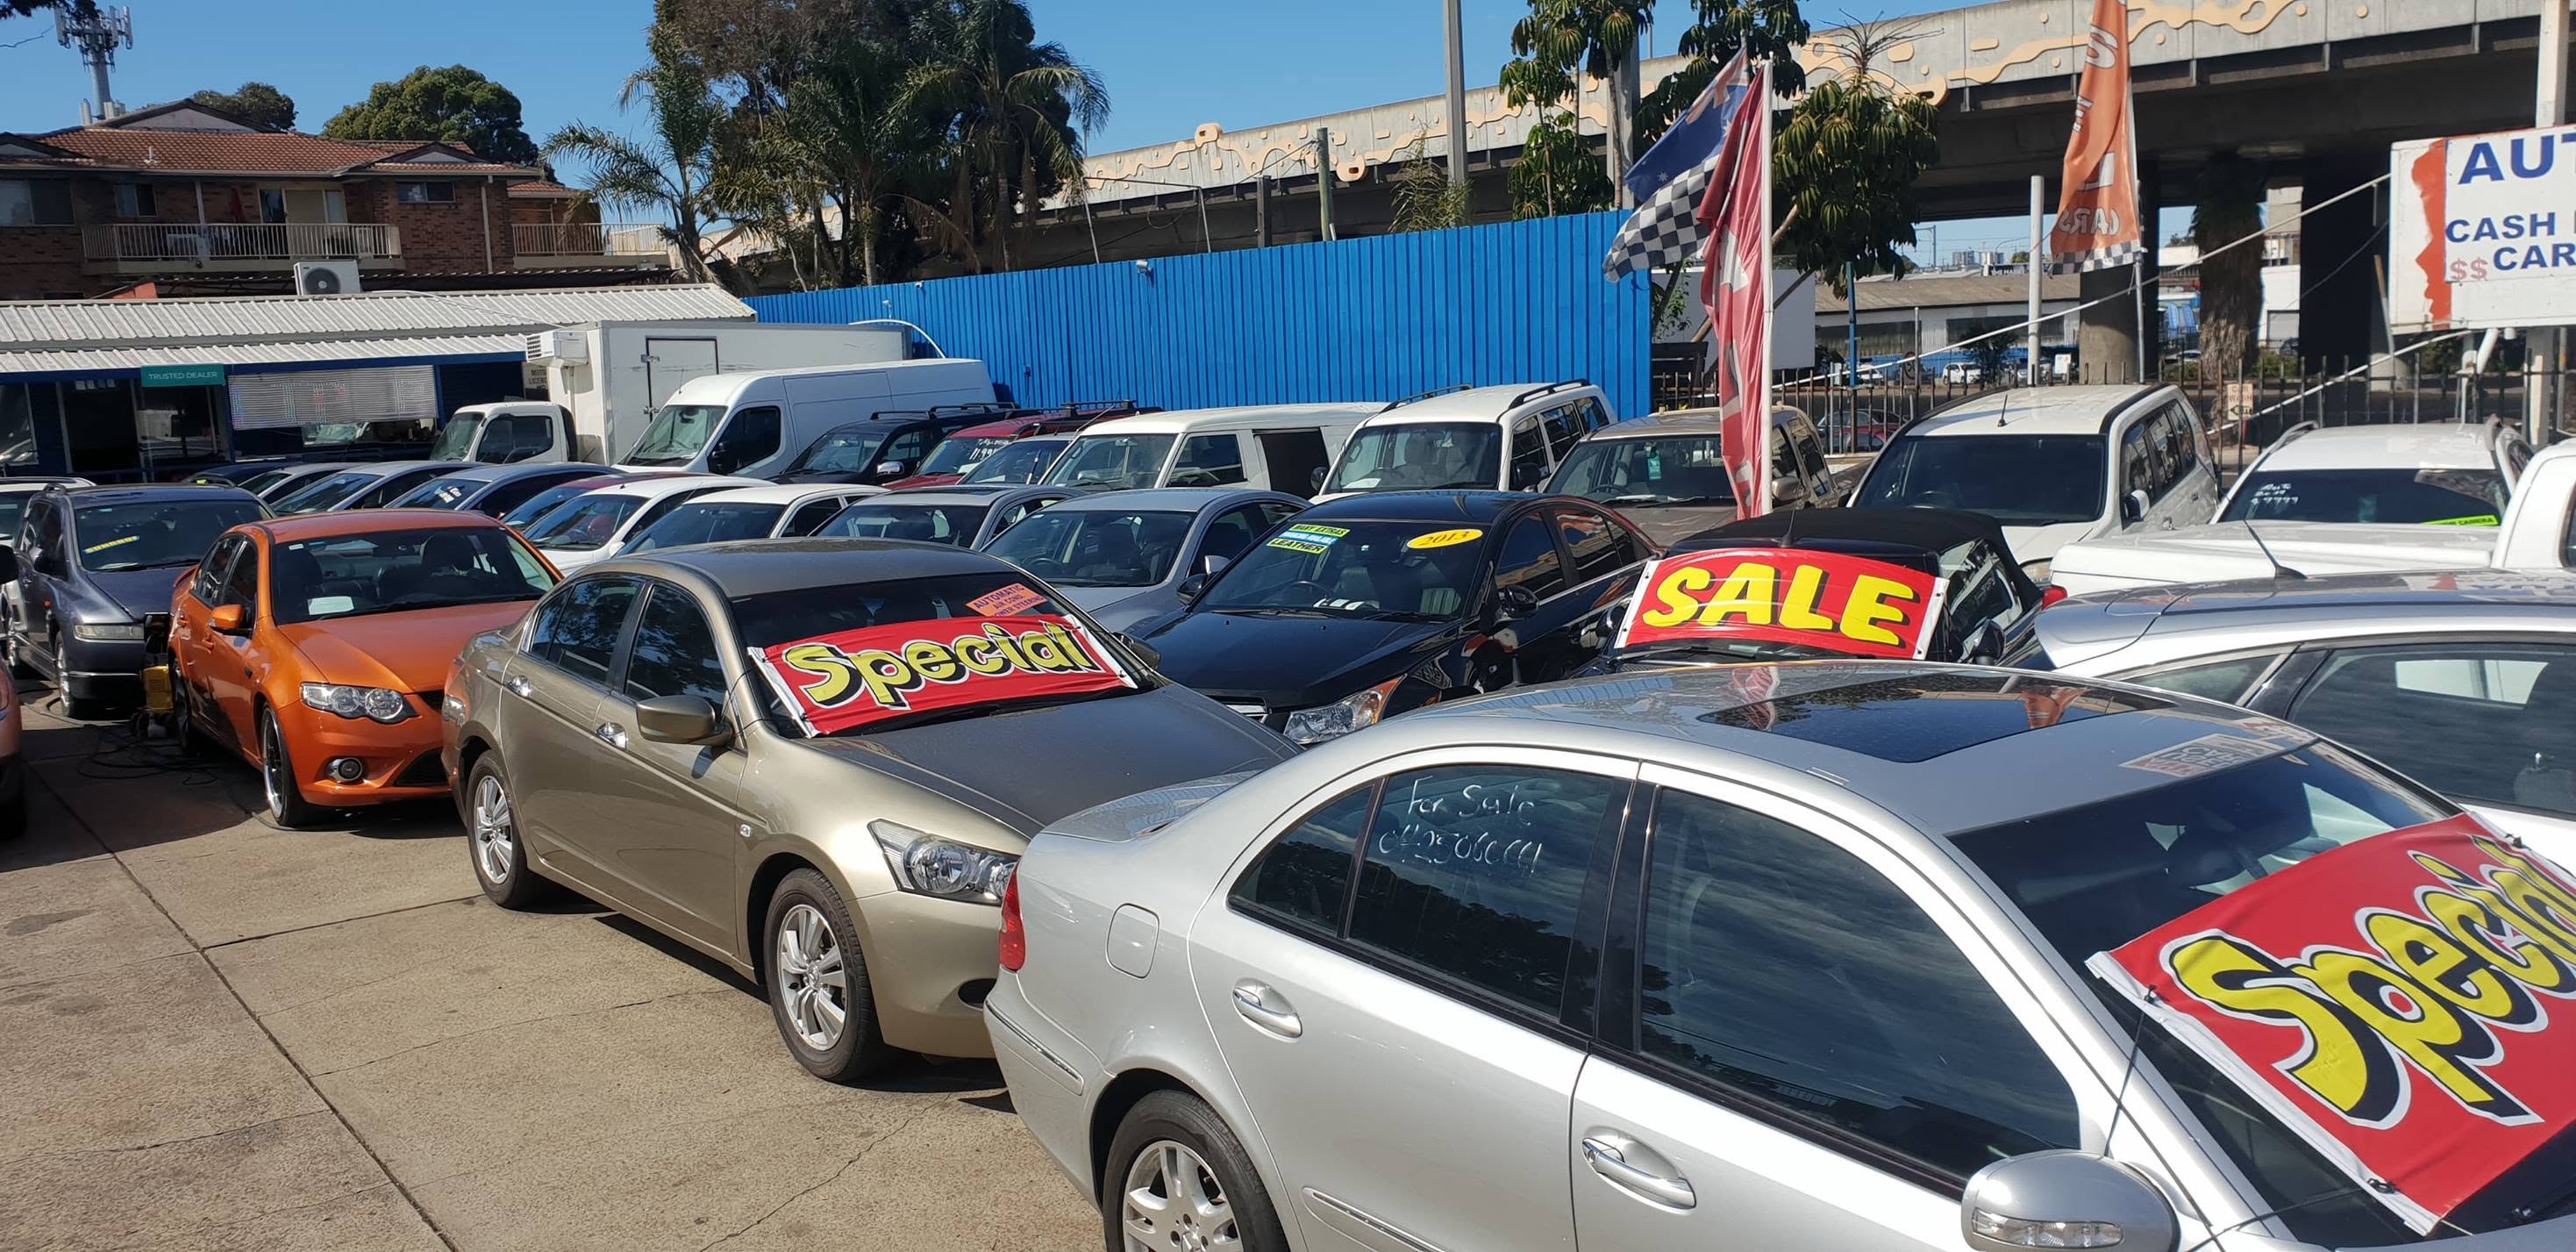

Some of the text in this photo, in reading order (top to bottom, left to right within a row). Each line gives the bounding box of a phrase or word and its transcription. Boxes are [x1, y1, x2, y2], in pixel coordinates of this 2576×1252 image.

[2445, 211, 2556, 243] CASH
[1272, 538, 1323, 552] LEATHER
[1418, 531, 1470, 546] 2013
[973, 583, 1025, 609] AUTOMATIC
[1642, 562, 1921, 648] SALE
[994, 605, 1015, 618] OWER
[783, 621, 1106, 710] Special
[1408, 775, 1535, 826] For Sale
